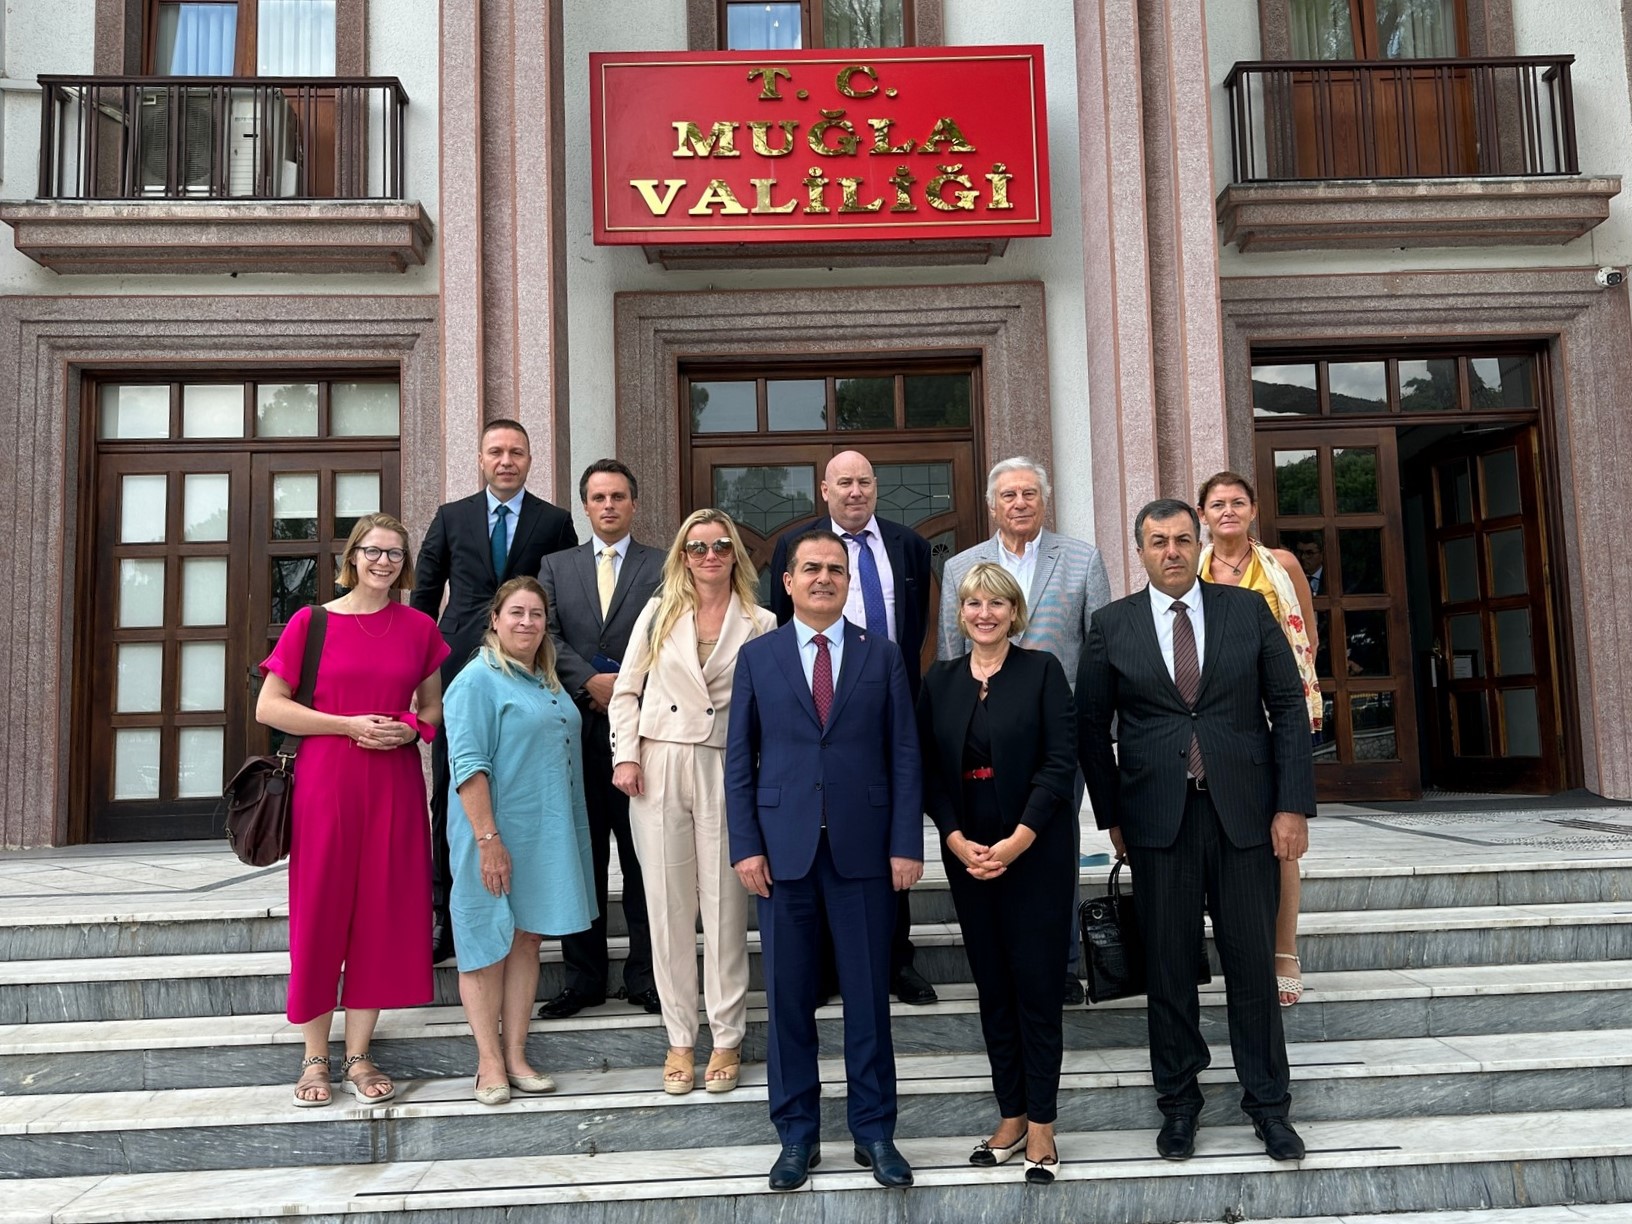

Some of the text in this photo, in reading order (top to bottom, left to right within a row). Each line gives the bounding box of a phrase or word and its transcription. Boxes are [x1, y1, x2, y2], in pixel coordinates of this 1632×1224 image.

[747, 65, 899, 101] T. C.
[671, 109, 976, 159] MUĞLA
[630, 162, 1014, 216] VALİLİĞİ
